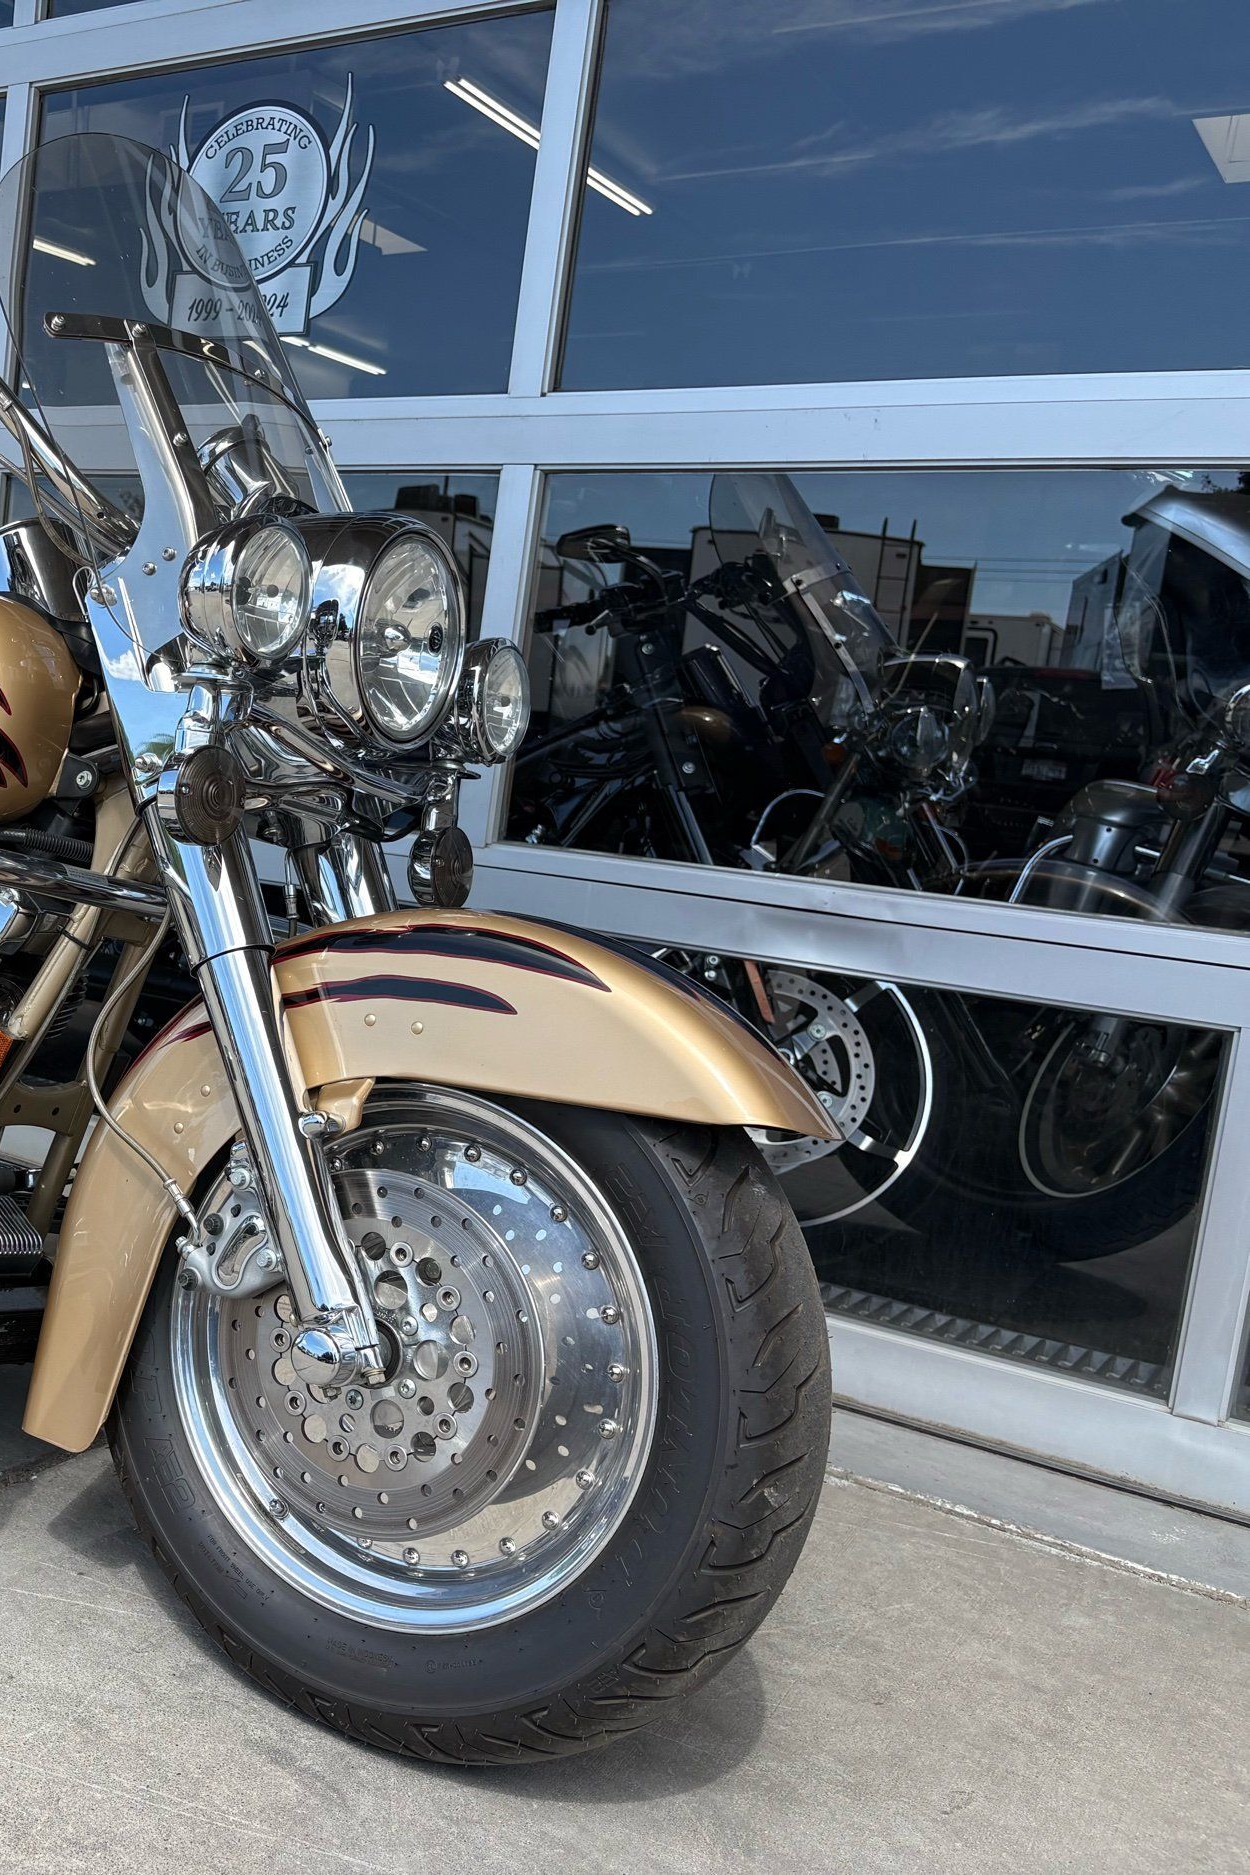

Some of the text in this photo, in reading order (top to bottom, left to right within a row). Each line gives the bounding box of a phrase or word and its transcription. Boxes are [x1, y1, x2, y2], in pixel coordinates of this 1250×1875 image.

[205, 117, 312, 160] CELEBRATING
[219, 138, 291, 203] 25
[198, 206, 297, 239] YEARS
[196, 243, 211, 262] IN
[187, 297, 222, 323] 1999
